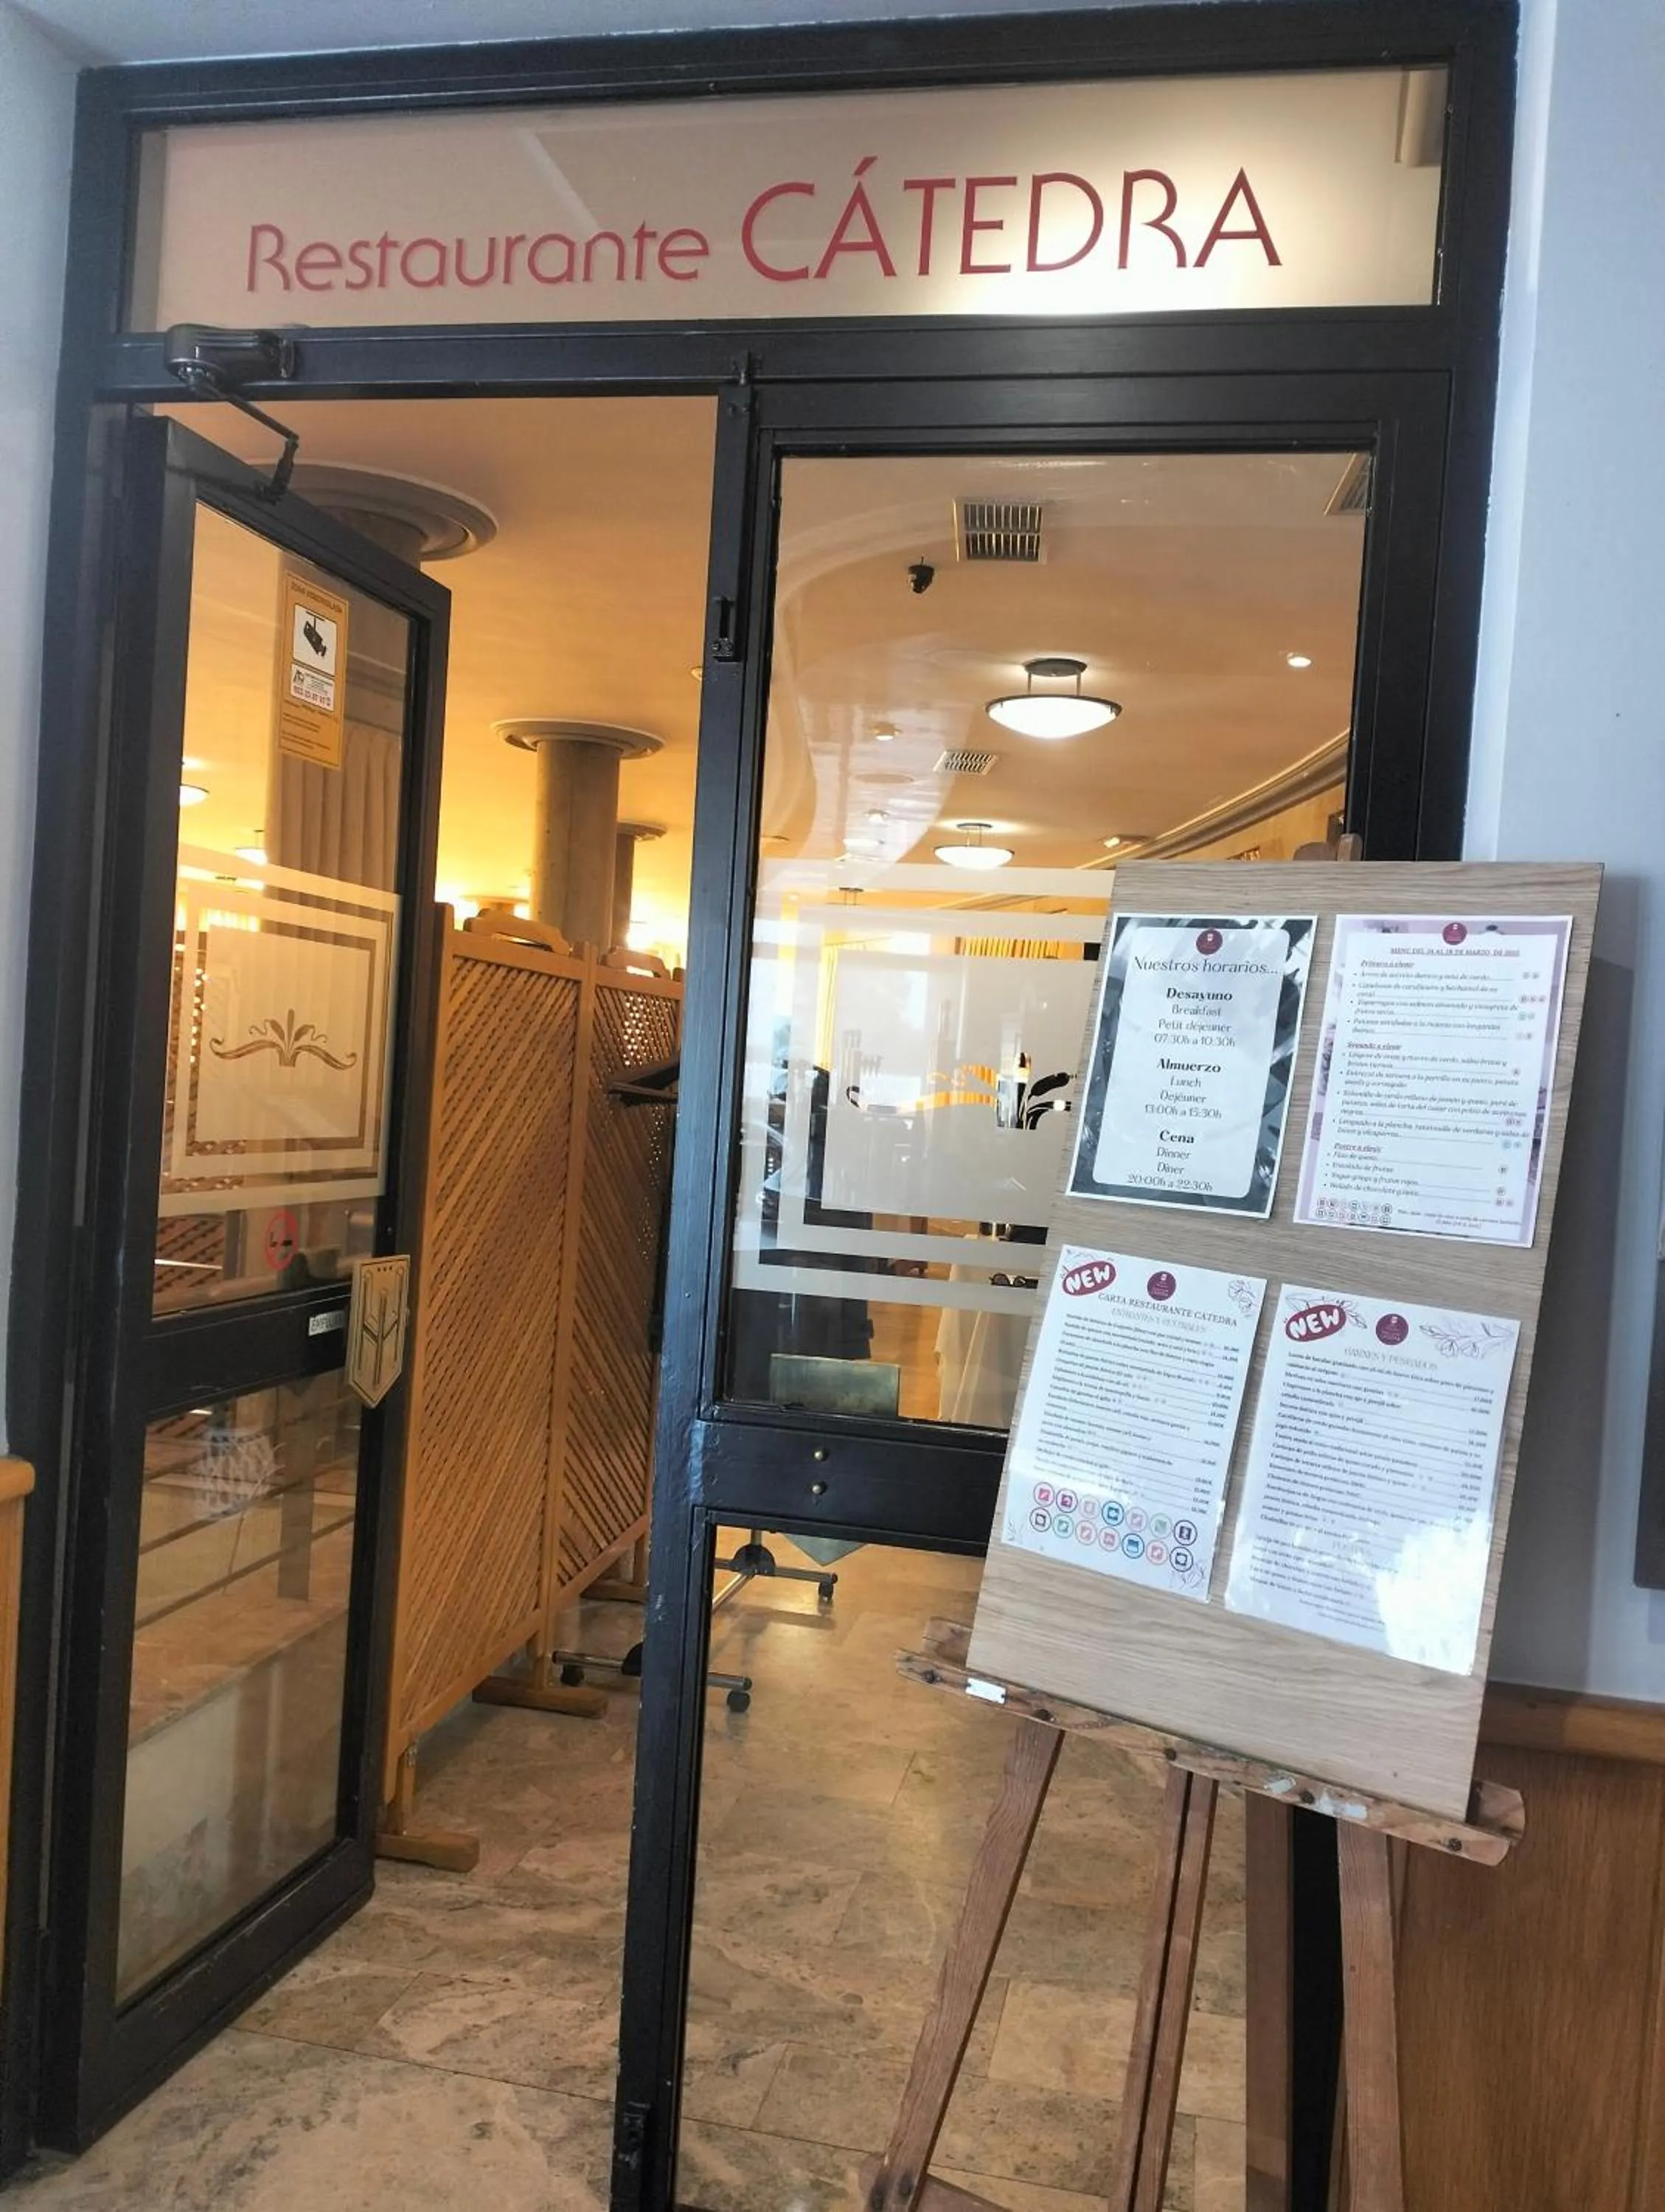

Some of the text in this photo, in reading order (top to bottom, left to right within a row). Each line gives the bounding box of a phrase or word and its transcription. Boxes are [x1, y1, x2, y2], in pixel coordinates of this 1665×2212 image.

[247, 156, 1282, 293] Restaurante CÁTEDRA
[1134, 956, 1199, 972] Nuestros
[1166, 987, 1233, 1001] Desayuno
[1172, 1004, 1222, 1018] Breakfast
[1157, 1058, 1221, 1073] Almuerzo
[1170, 1076, 1201, 1088] Lunch
[1159, 1130, 1195, 1144] Cena
[1156, 1147, 1191, 1159] Dinner
[1066, 1265, 1110, 1294] NEW
[1098, 1293, 1127, 1305] CARTA
[1289, 1308, 1340, 1339] NEW
